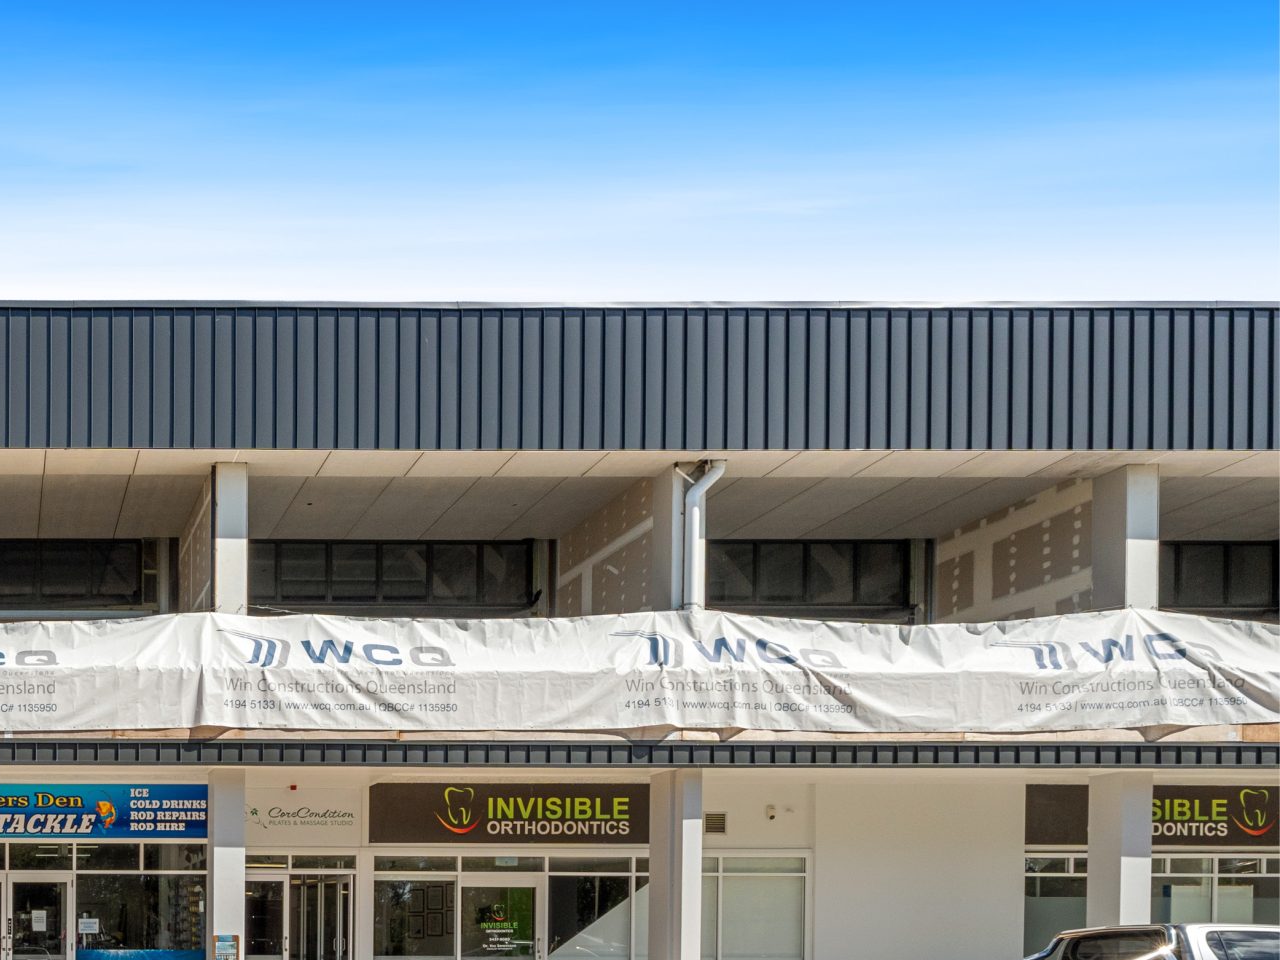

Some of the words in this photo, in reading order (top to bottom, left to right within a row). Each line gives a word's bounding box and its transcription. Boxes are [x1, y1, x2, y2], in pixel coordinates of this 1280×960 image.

[301, 639, 456, 667] WCQ
[692, 636, 847, 668] WCQ
[225, 678, 253, 692] Win
[256, 679, 362, 694] Constructions
[366, 679, 457, 696] Queensland
[625, 678, 655, 693] Win
[1020, 681, 1048, 696] Win
[1052, 678, 1154, 694] Constructions
[18, 703, 58, 713] 1135950
[223, 699, 247, 710] 4194
[250, 700, 276, 710] 5133
[284, 702, 372, 712] www.wcq.com.au
[378, 702, 415, 712] QBCC#
[418, 702, 458, 712] 1135950
[624, 699, 651, 710] 4194
[814, 704, 853, 714] 1135950
[1018, 702, 1042, 712] 4194
[1080, 698, 1168, 710] www.wcq.com.au
[130, 788, 149, 798] ICE
[36, 794, 83, 808] Den
[130, 800, 160, 809] COLD
[162, 800, 207, 809] DRINKS
[487, 796, 630, 820] INVISIBLE
[130, 811, 155, 820] ROD
[156, 811, 206, 820] REPAIRS
[268, 806, 355, 818] CoreCondition
[1152, 798, 1228, 821] SIBLE
[130, 822, 155, 831] ROD
[156, 822, 186, 831] HIRE
[486, 820, 630, 836] ORTHODONTICS
[1152, 822, 1228, 836] DONTICS
